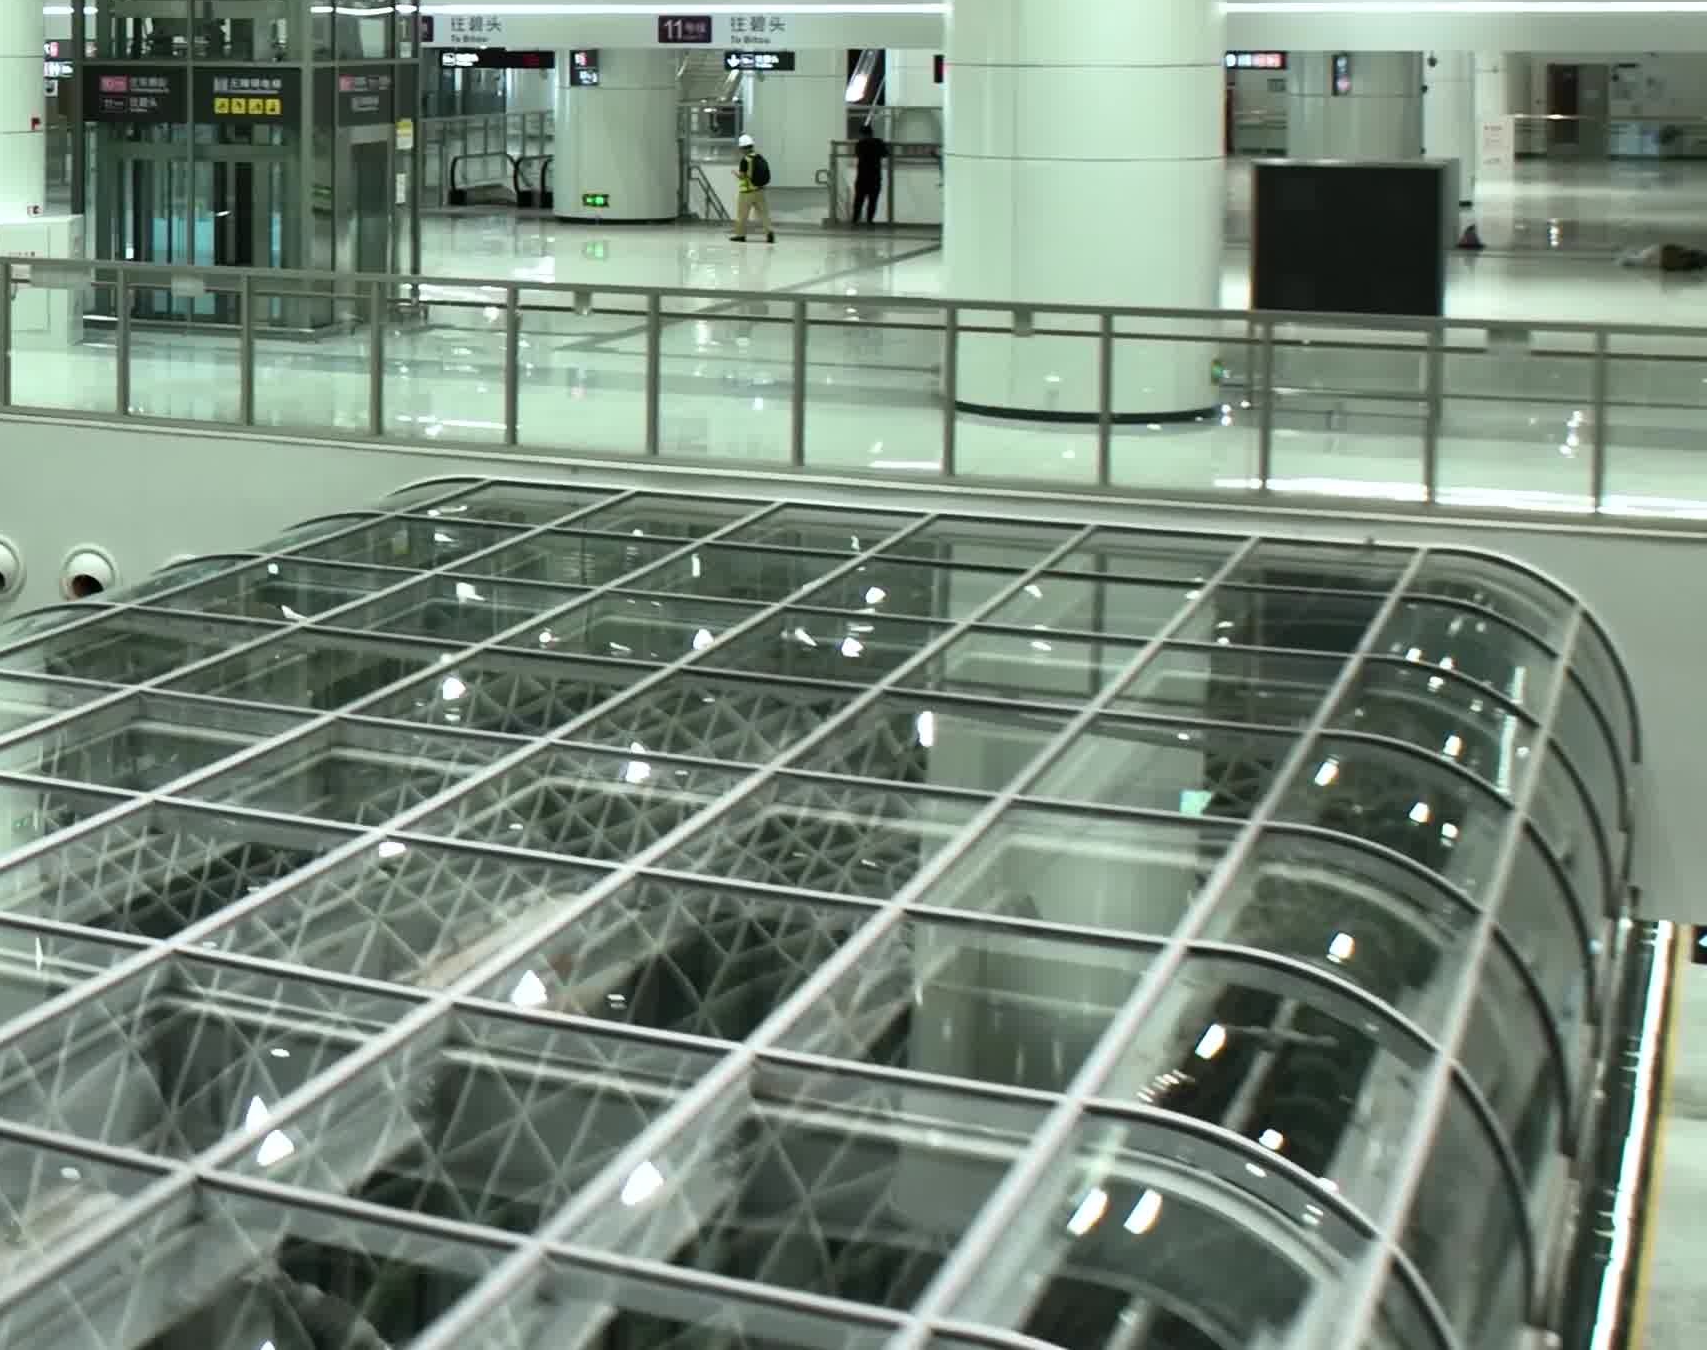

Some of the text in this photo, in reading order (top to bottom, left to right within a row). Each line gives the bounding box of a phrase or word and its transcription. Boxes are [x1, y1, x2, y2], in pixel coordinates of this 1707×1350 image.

[450, 16, 502, 33] 往碧头
[730, 16, 786, 33] 往碧头
